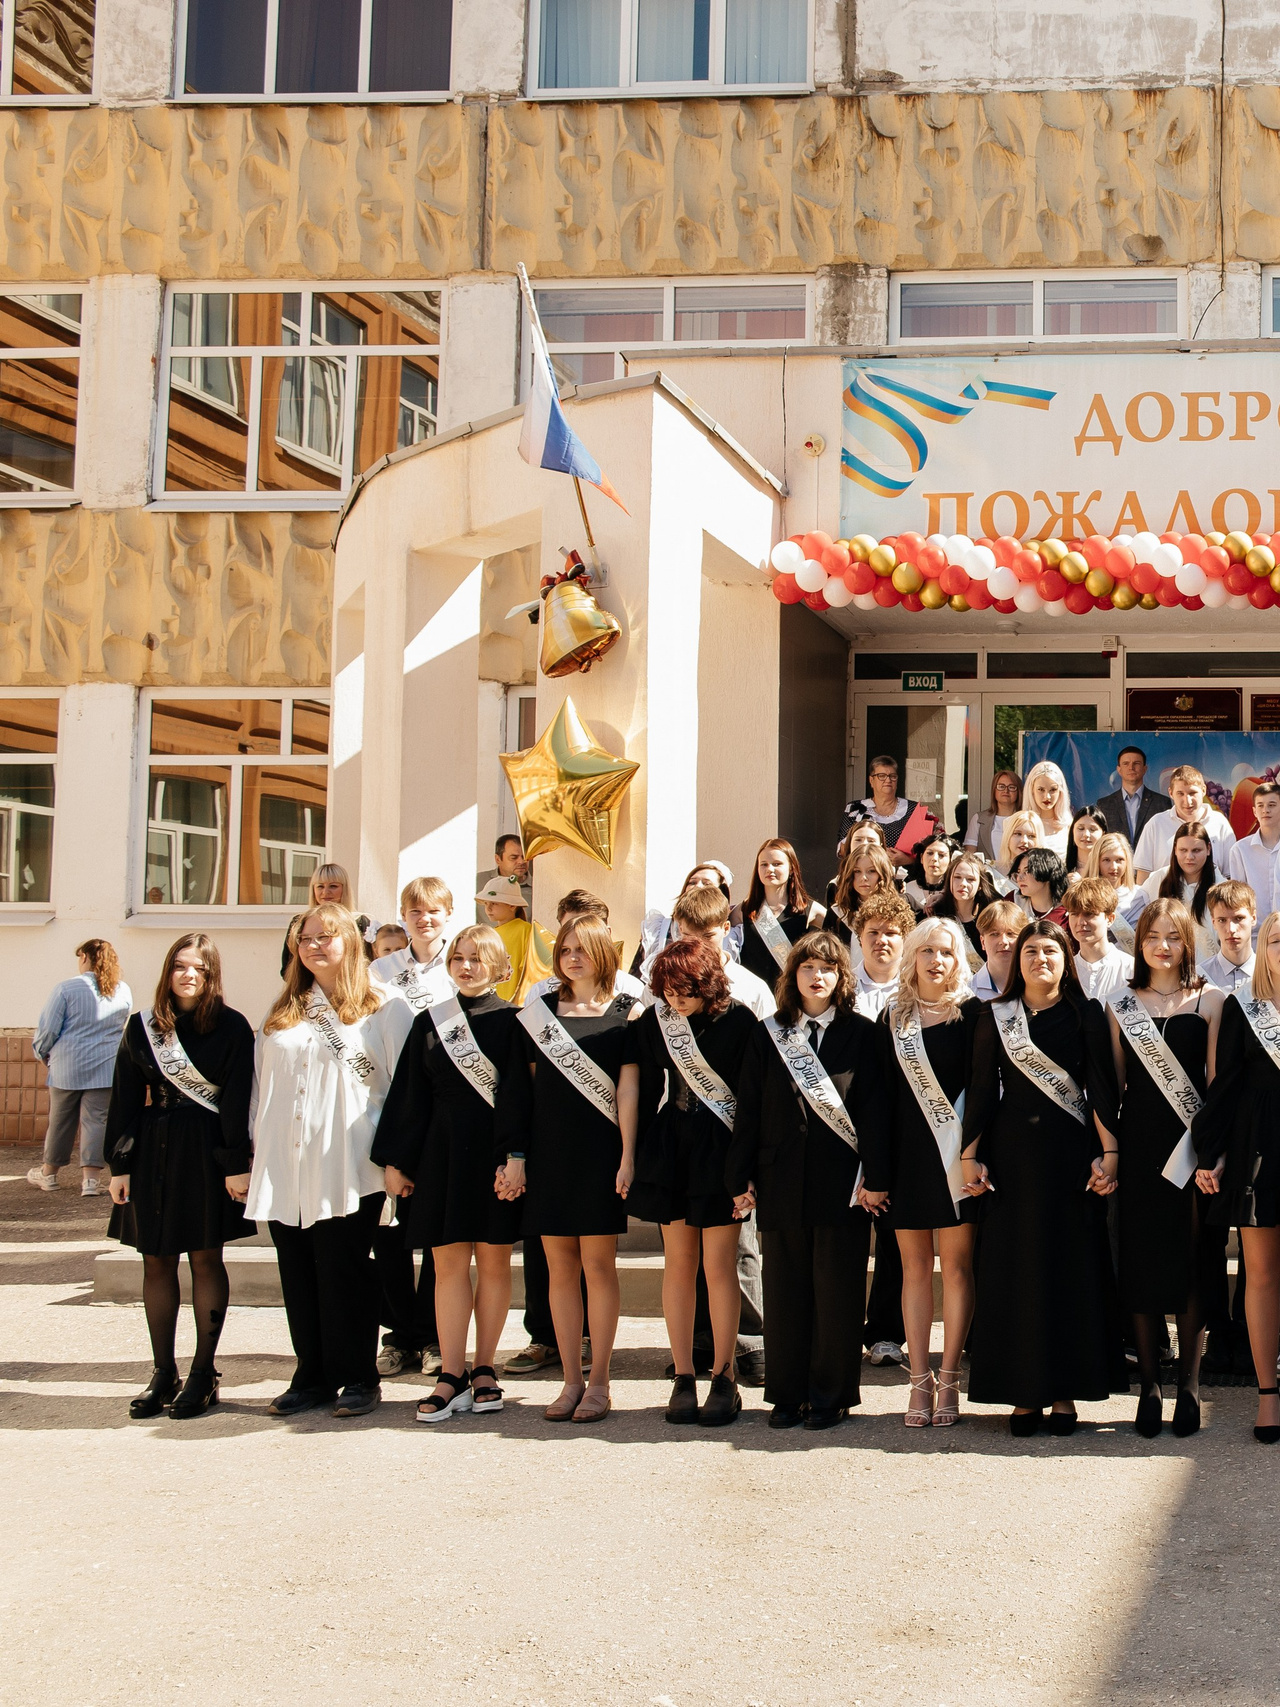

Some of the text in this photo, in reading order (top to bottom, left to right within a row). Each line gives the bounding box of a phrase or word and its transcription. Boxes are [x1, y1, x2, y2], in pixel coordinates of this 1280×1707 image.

[908, 676, 938, 689] ВХОД
[912, 761, 931, 771] ВХОД
[306, 996, 375, 1078] Выпускник 2025
[665, 1024, 717, 1101] Выпускник
[897, 1020, 955, 1124] Выпускник 2025
[1007, 1036, 1071, 1104] Выпускник
[1122, 1013, 1201, 1114] Выпускник 2025
[549, 1042, 615, 1113] Выпускник
[785, 1045, 837, 1120] Выпускник
